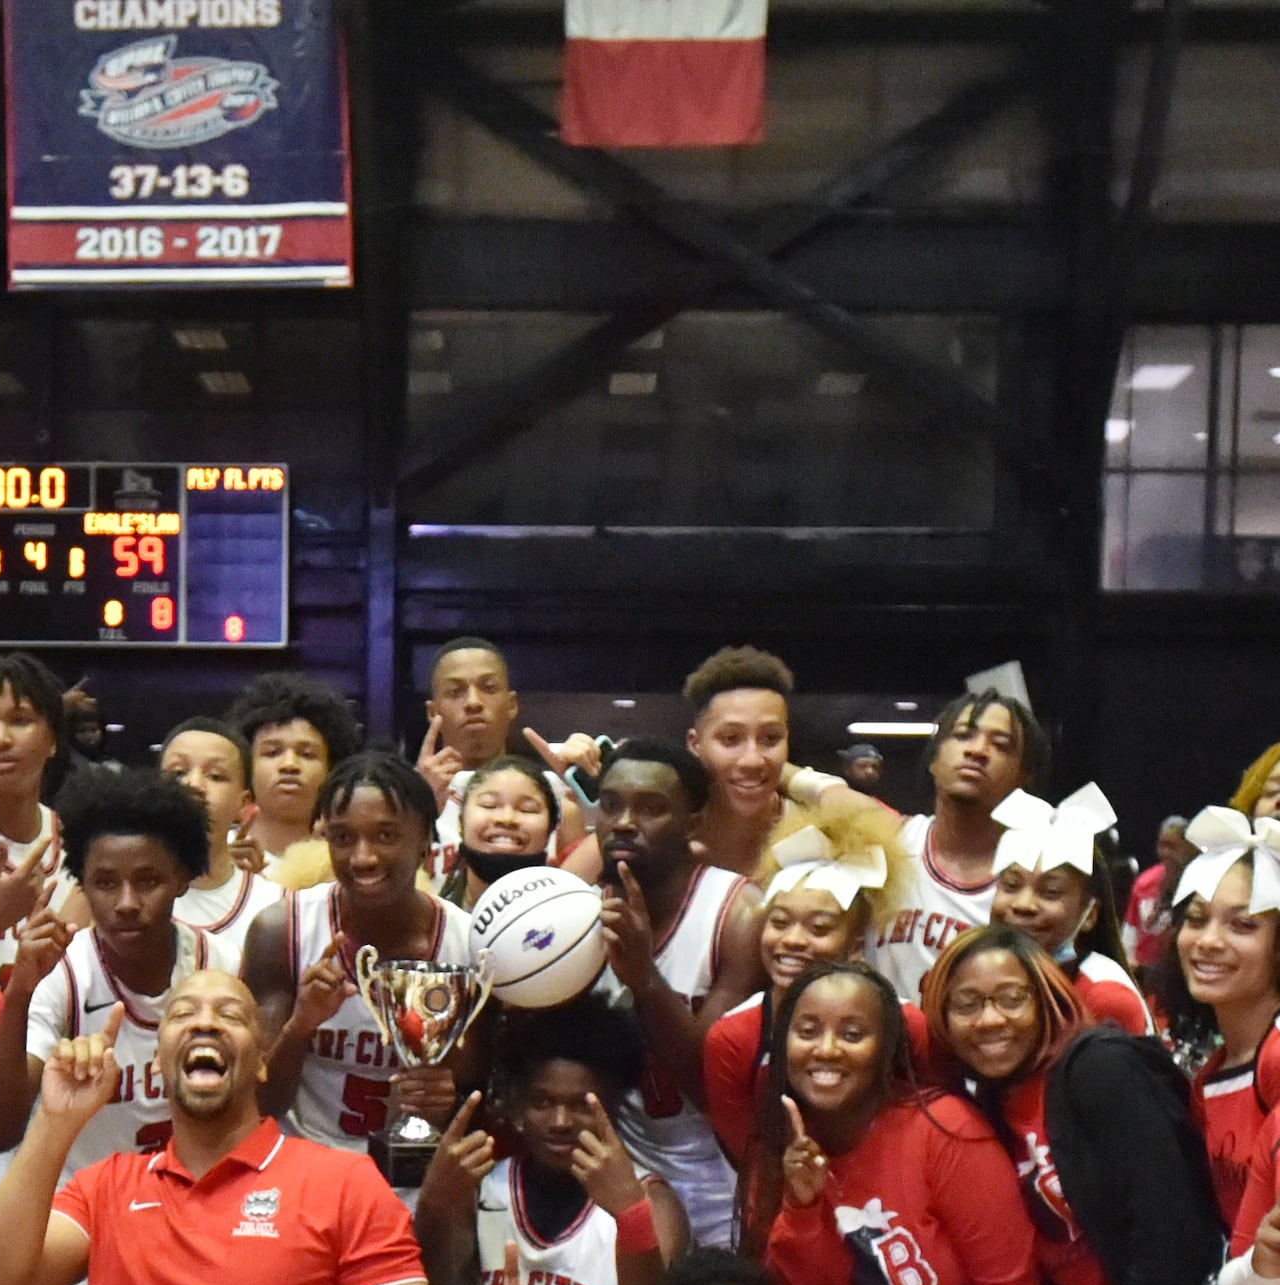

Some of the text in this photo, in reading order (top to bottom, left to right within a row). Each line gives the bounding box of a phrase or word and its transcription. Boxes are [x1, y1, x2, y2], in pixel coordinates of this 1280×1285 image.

[73, 0, 282, 29] CHAMPIONS
[109, 164, 249, 199] 37-13-6
[75, 226, 164, 260] 2016
[196, 225, 282, 258] 2017
[23, 541, 48, 571] 4
[113, 535, 166, 579] 59
[473, 876, 557, 936] Wilson
[338, 1072, 391, 1137] 5
